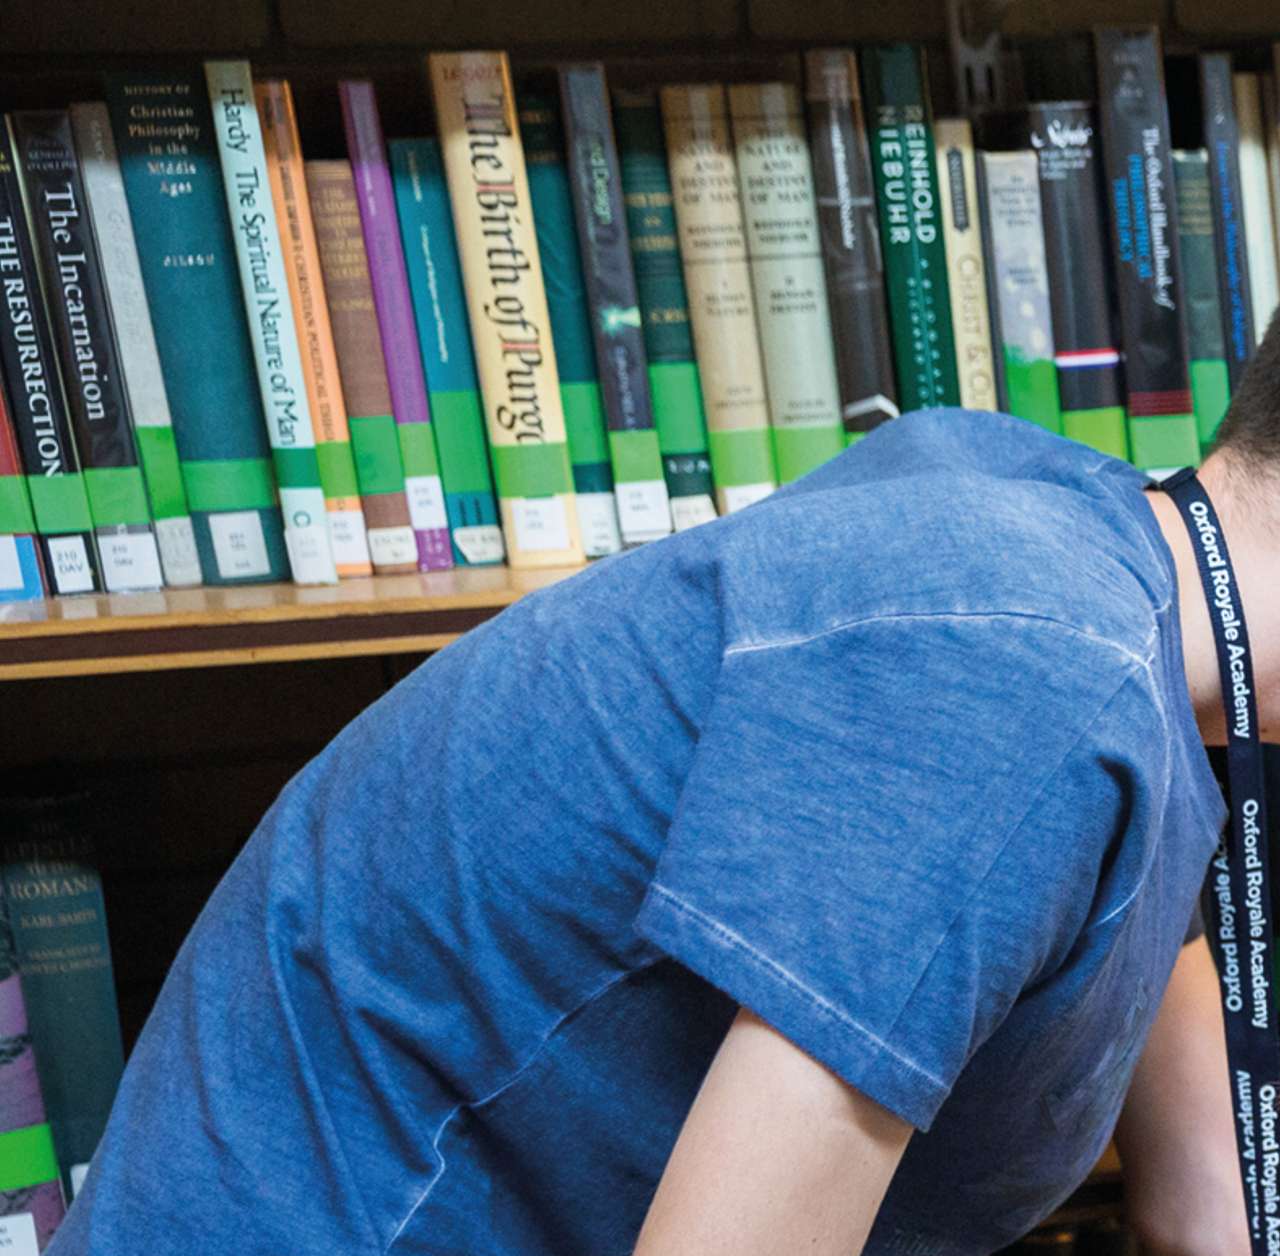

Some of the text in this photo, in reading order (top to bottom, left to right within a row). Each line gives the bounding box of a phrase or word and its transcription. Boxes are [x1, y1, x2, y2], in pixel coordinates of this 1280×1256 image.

[128, 124, 201, 140] Philosophy
[130, 105, 194, 118] Christian
[221, 88, 251, 154] Hardy
[462, 93, 514, 172] The
[1141, 124, 1161, 156] The
[147, 160, 197, 176] Middle
[149, 142, 188, 155] in the
[878, 105, 912, 244] NIEBUHR
[905, 104, 936, 244] REINHOLD
[160, 181, 193, 198] Ages
[1145, 156, 1167, 211] Oxford
[474, 176, 532, 288] Birth
[1150, 211, 1173, 285] Handbook
[44, 181, 109, 421] The Incarnation
[236, 166, 298, 446] The Spiritual Nature of Man
[484, 294, 539, 335] of
[0, 216, 64, 478] THE RESURRECTION
[1189, 500, 1250, 740] Oxford Royale Academy
[1214, 873, 1237, 941] Royale
[1242, 799, 1269, 1030] Oxford Royale Academy
[1223, 941, 1243, 1014] Oxford
[1258, 1085, 1280, 1152] Oxford
[1259, 1152, 1280, 1214] Royale
